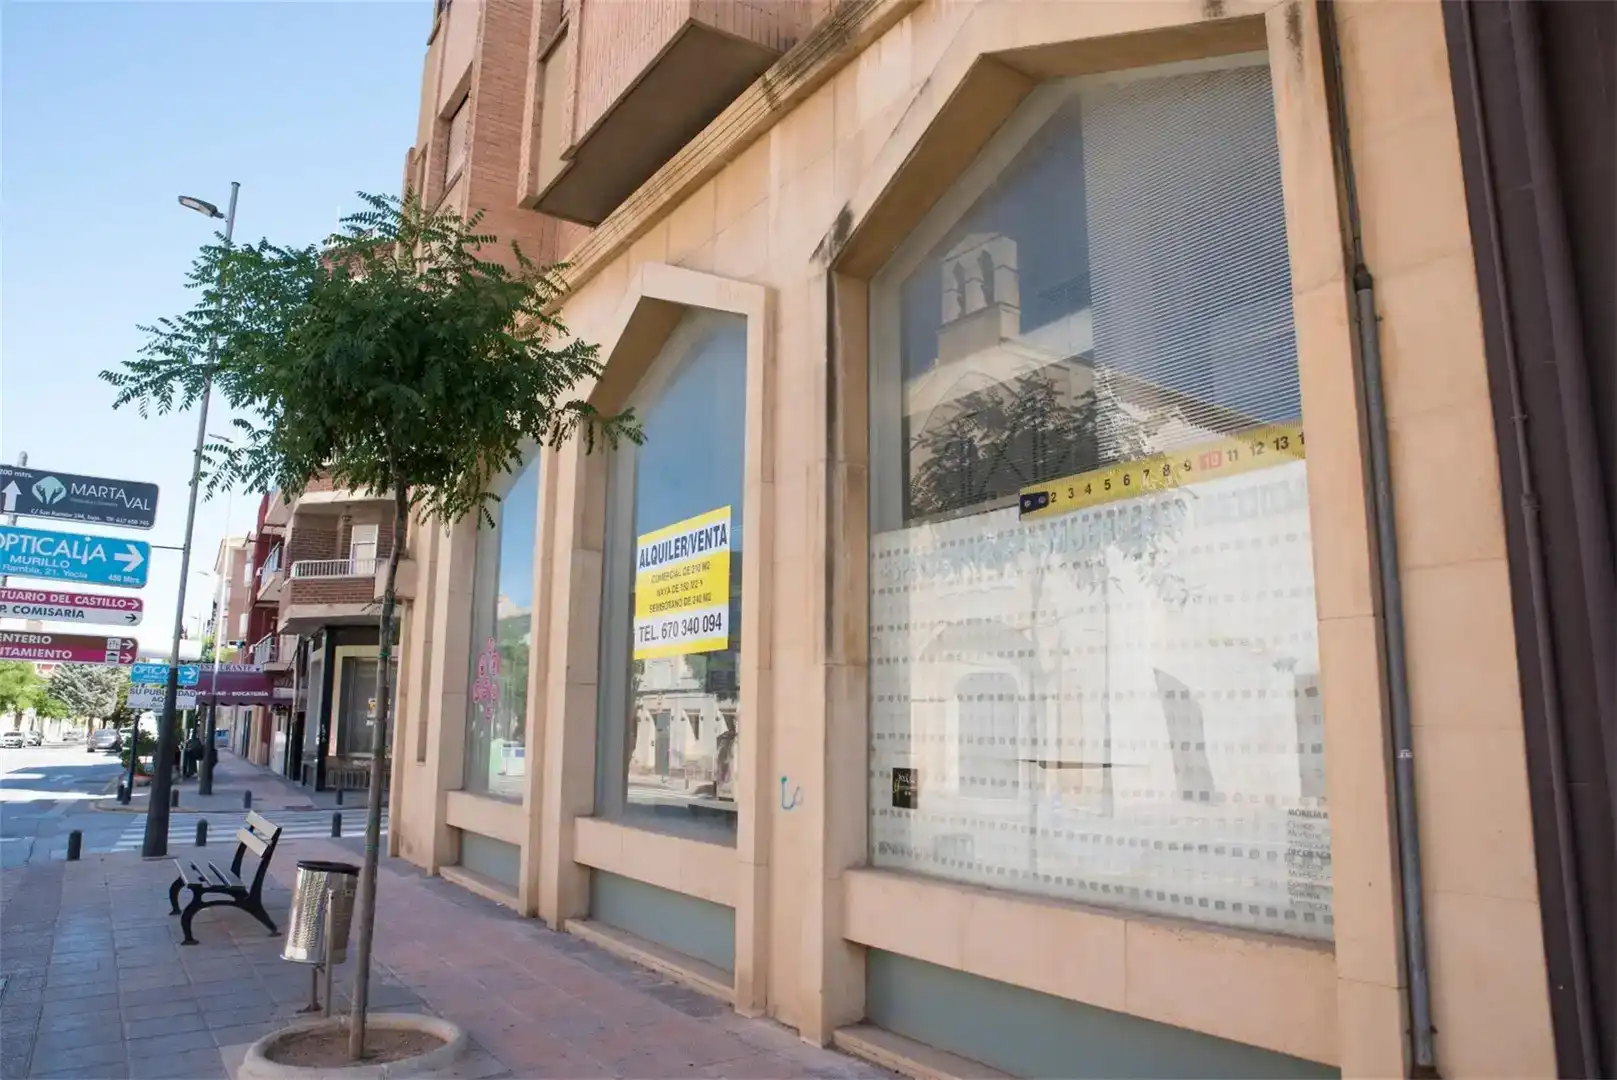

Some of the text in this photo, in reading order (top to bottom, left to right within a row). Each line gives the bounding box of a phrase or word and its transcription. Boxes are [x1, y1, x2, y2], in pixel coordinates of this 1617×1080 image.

[1050, 492, 1057, 502] 2
[1068, 487, 1075, 499] 3
[1085, 483, 1092, 495] 4
[1104, 479, 1111, 491] 5
[1123, 474, 1131, 486] 6
[1143, 469, 1150, 481] 7
[1163, 464, 1170, 476] 8
[1183, 460, 1192, 472] 9
[1203, 453, 1221, 468] 10
[1226, 449, 1239, 462] 11
[1249, 441, 1265, 456] 12
[1273, 436, 1289, 451] 13
[639, 523, 728, 569] ALQUILER/VENTA
[9, 555, 70, 569] MURILLO
[63, 570, 88, 579] Yecla
[651, 569, 682, 584] COMERCIAL
[49, 594, 71, 604] DEL
[74, 596, 127, 608] CASTILLO
[639, 612, 722, 643] TEL. 670 340 094
